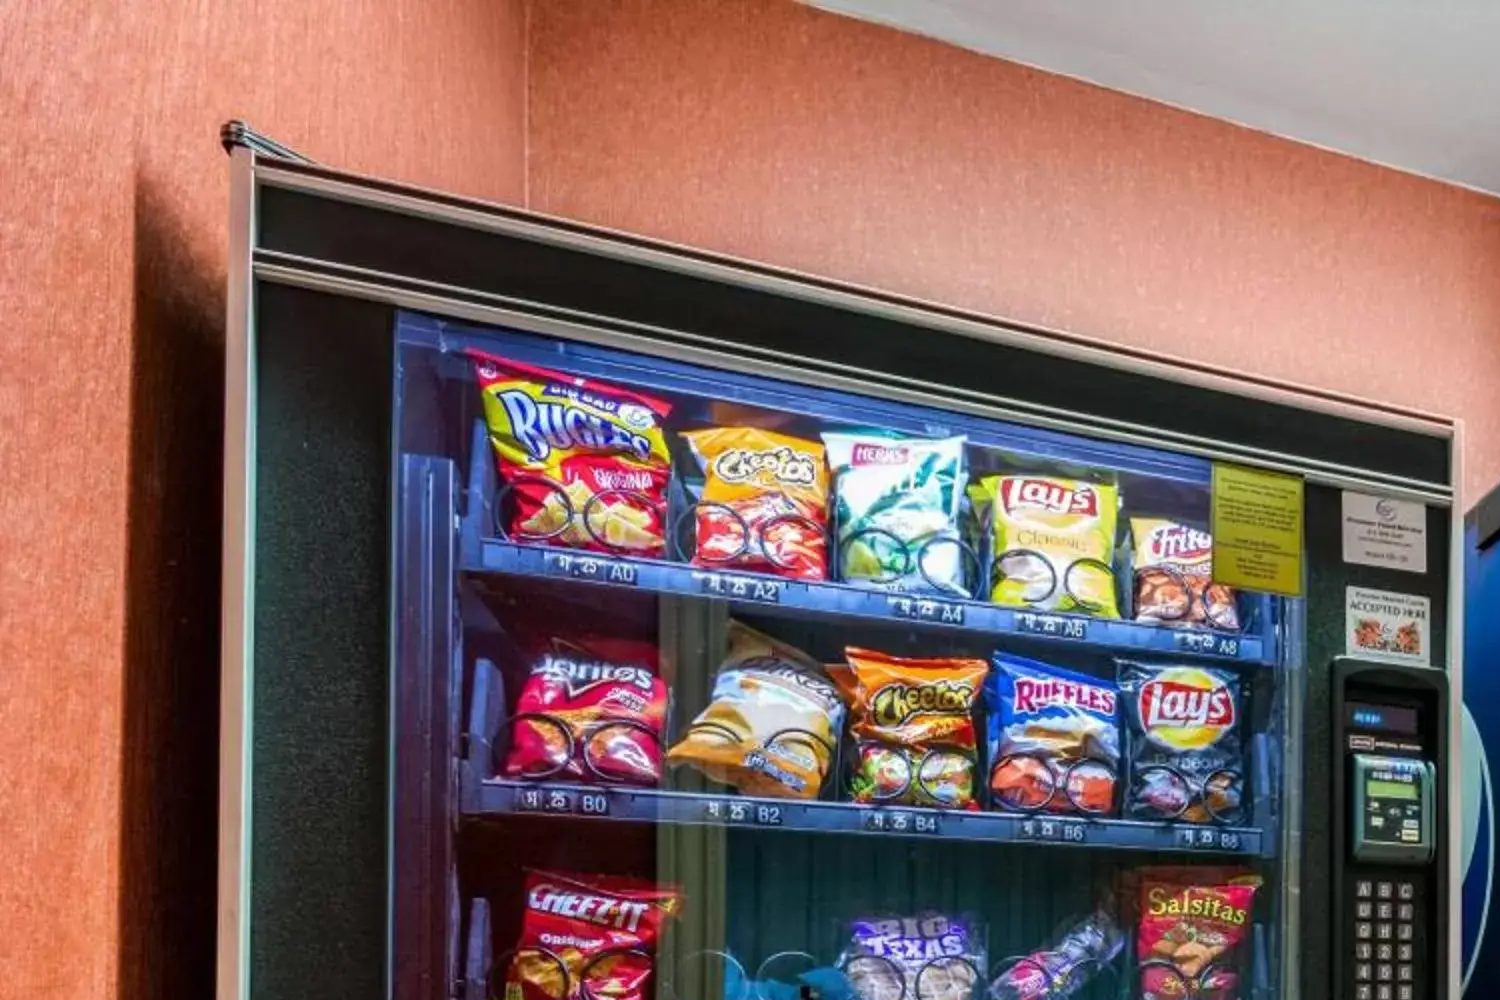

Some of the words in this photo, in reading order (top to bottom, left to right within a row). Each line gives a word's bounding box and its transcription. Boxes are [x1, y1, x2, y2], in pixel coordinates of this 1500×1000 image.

[497, 388, 652, 462] BUGLES
[1002, 477, 1098, 514] Lay's
[755, 582, 777, 598] A2
[941, 603, 961, 620] A4
[1063, 620, 1083, 638] A6
[1219, 638, 1237, 655] A8
[874, 683, 972, 727] Cheetos
[1013, 677, 1116, 716] RUFFLES
[1148, 681, 1229, 727] Lay's
[758, 805, 780, 825] B2
[915, 815, 936, 833] B4
[1064, 823, 1084, 842] B6
[1148, 887, 1248, 926] Salsitas
[862, 934, 964, 960] TEXAS
